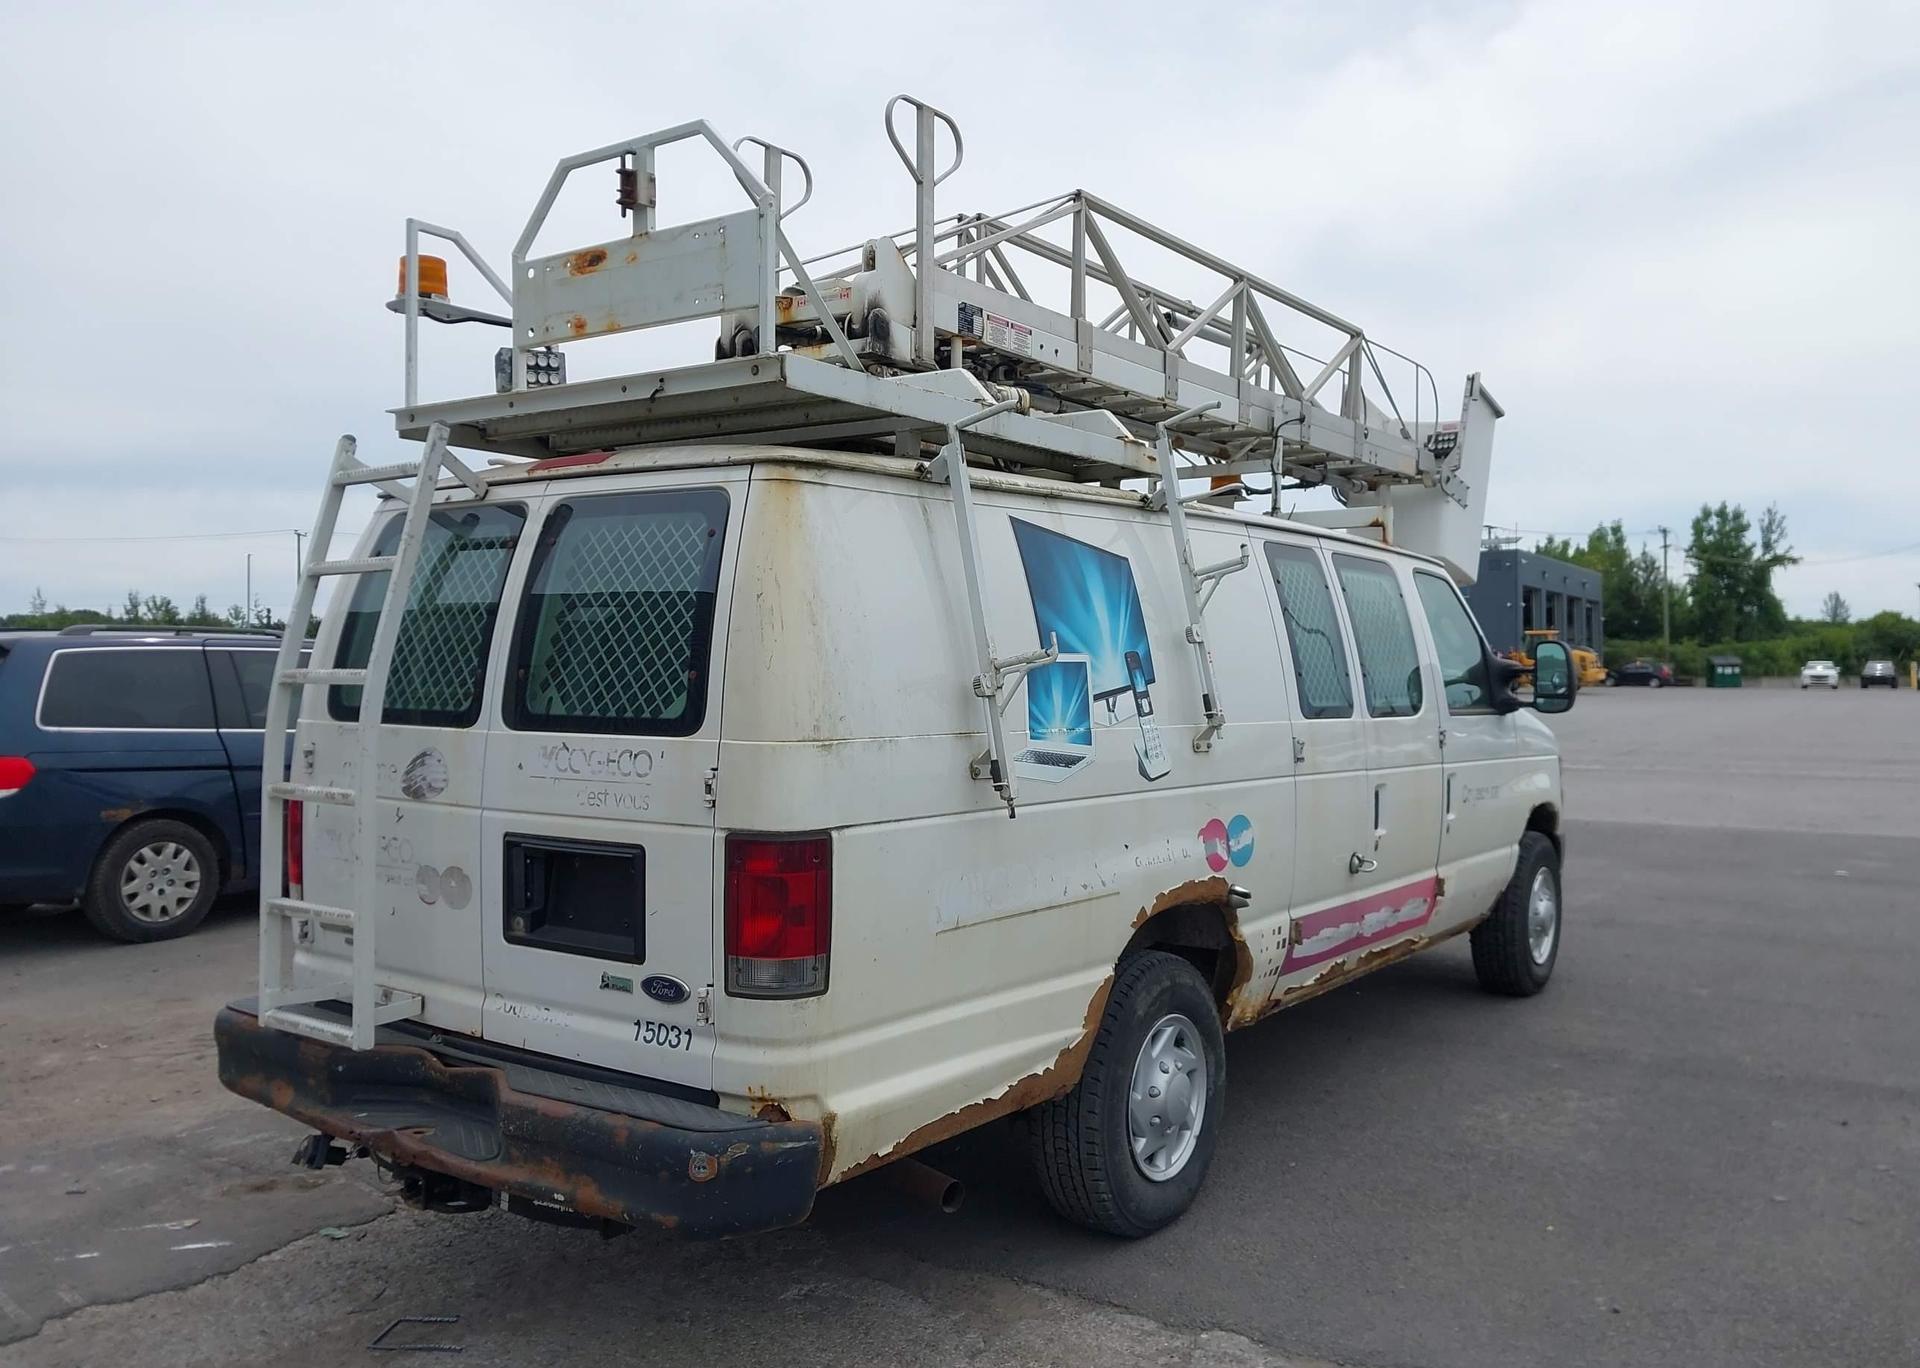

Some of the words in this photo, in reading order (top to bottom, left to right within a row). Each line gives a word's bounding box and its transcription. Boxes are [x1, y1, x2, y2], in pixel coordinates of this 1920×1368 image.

[614, 793, 650, 811] vous
[651, 979, 676, 997] Ford
[634, 1019, 693, 1051] 15031
